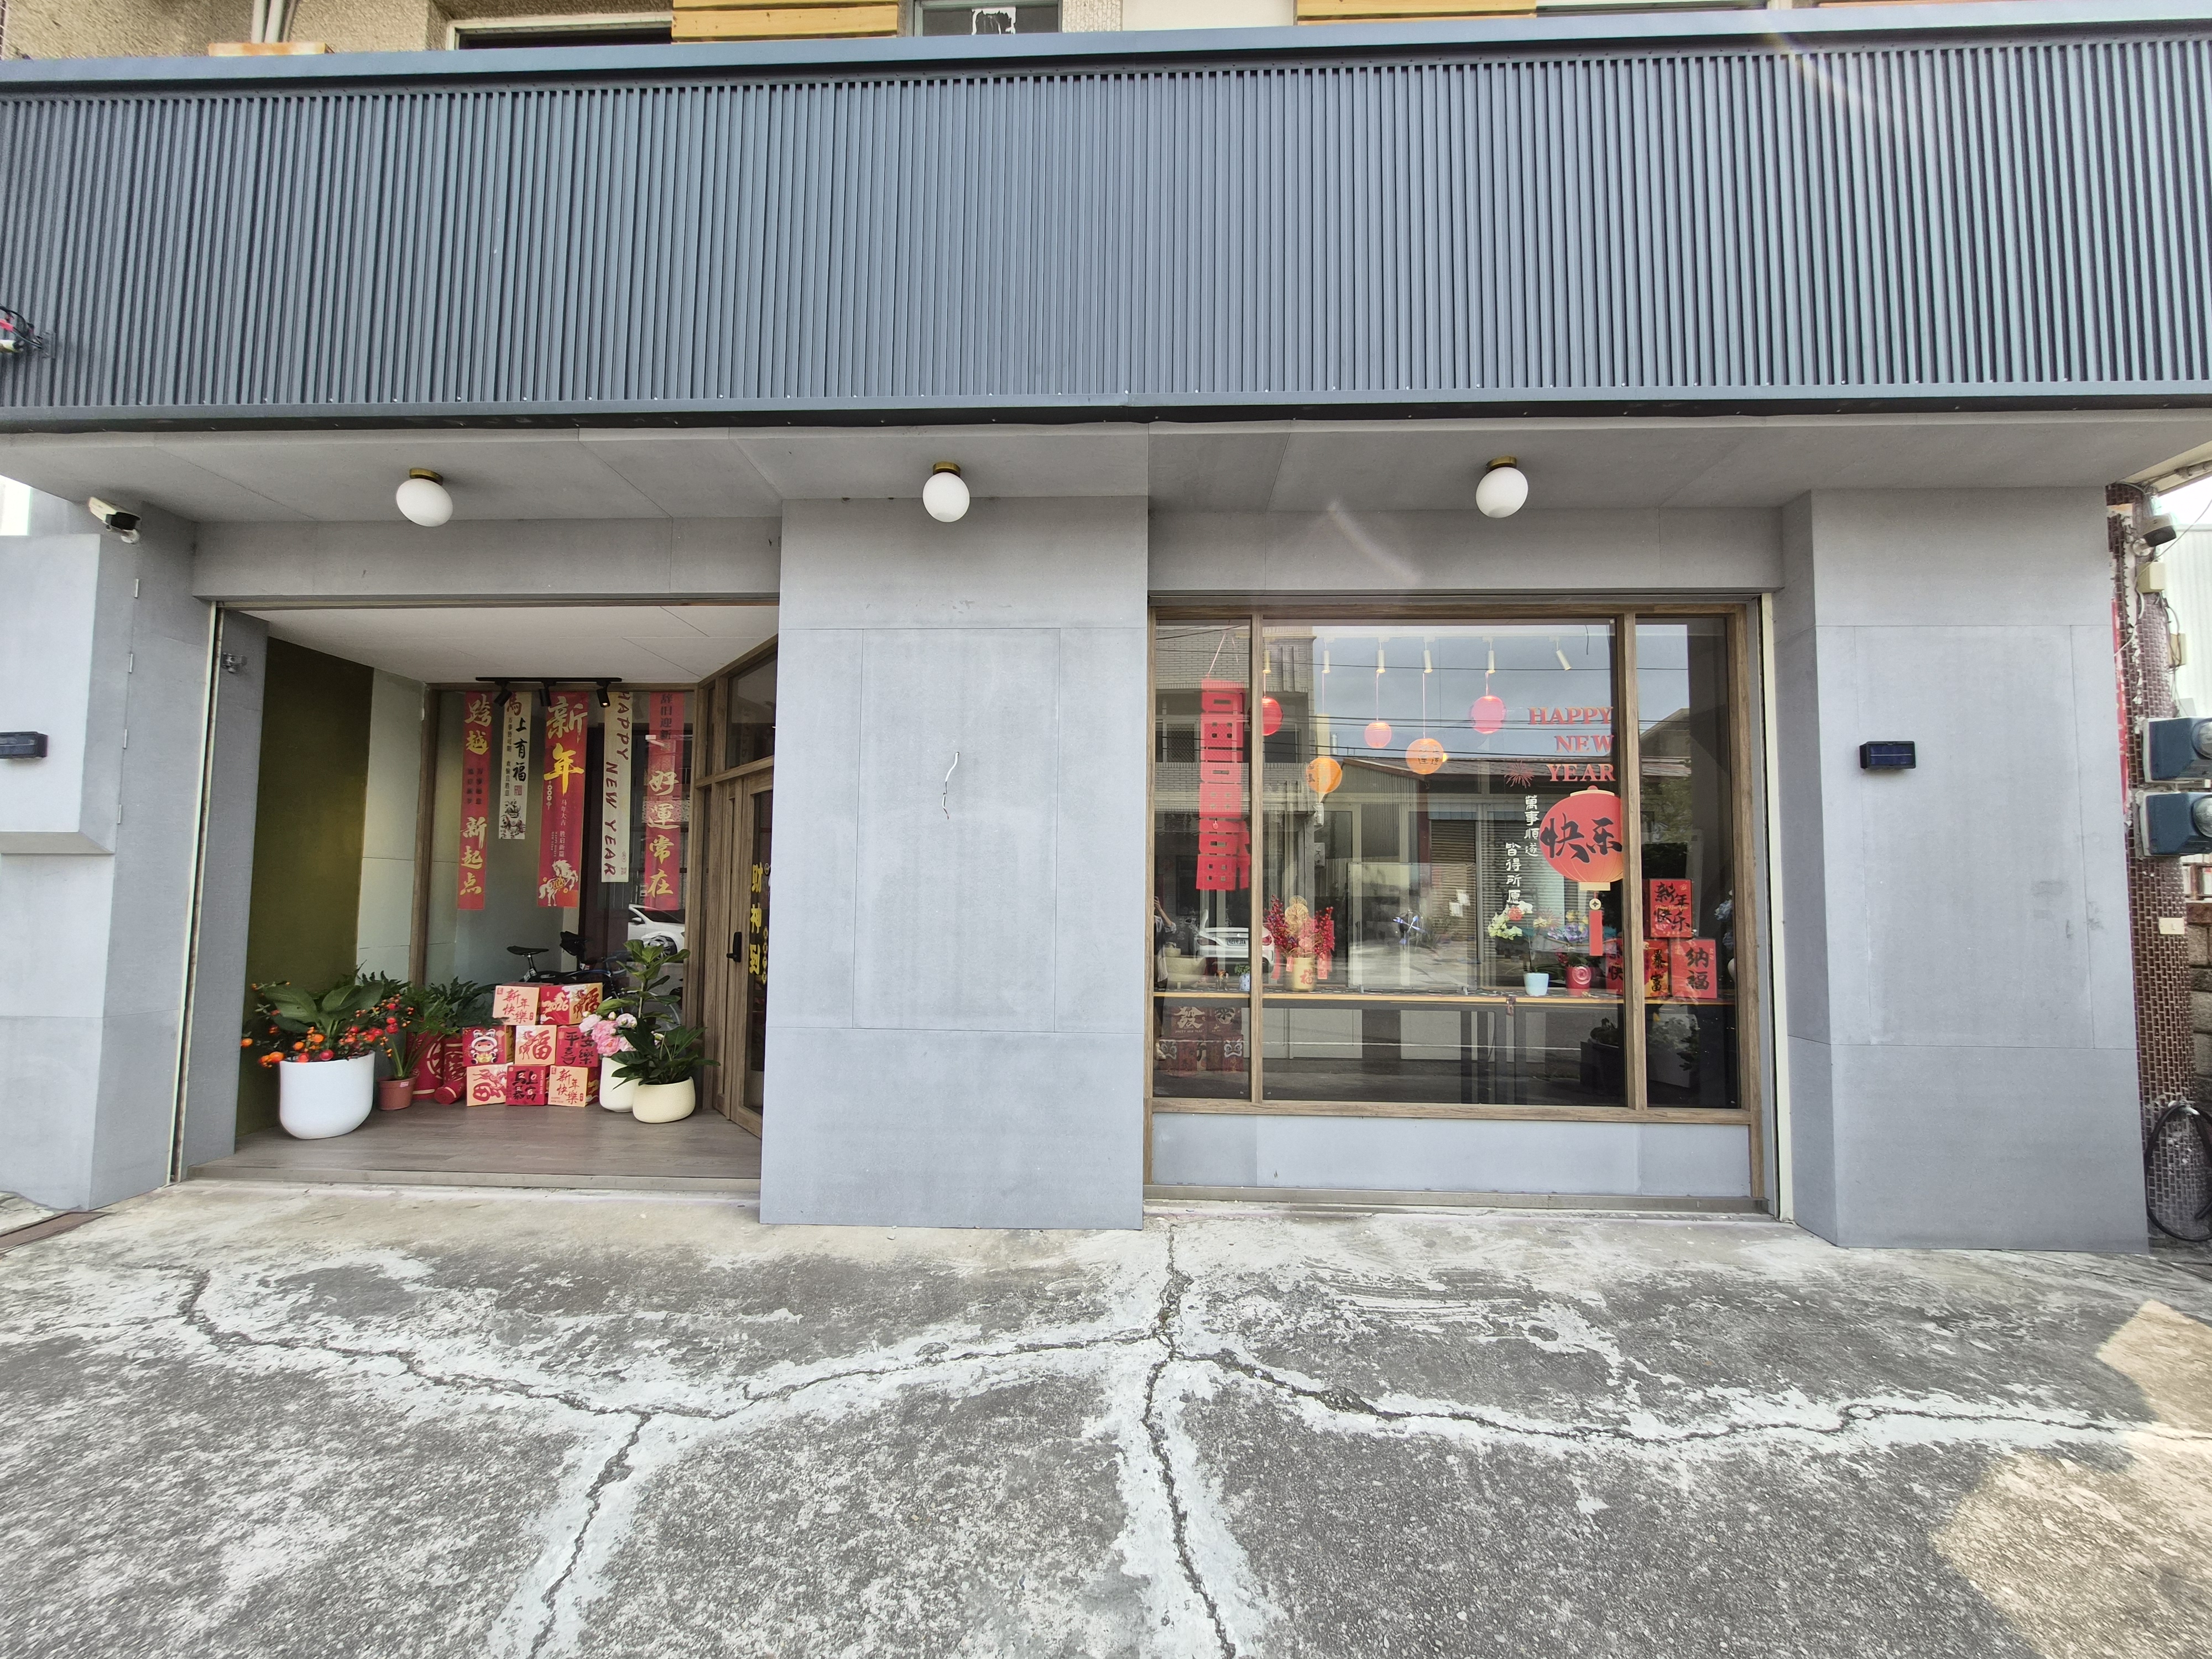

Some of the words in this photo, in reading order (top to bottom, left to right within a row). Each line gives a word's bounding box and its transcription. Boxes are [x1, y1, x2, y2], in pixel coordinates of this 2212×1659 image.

[465, 693, 492, 755] 跨越
[617, 691, 630, 760] HAPPY
[1528, 707, 1613, 725] HAPPY
[544, 696, 588, 796] 新年
[1554, 735, 1614, 753] NEW
[606, 761, 618, 809] NEW
[1546, 764, 1615, 781] YEAR
[604, 820, 616, 876] YEAR
[647, 770, 680, 898] 好運常在
[1524, 795, 1540, 857] 萬事順遂
[1540, 813, 1623, 863] 快乐
[460, 816, 487, 896] 新起点
[1505, 842, 1522, 905] 皆得所愿
[1686, 947, 1709, 990] 纳福
[542, 1000, 569, 1012] 2026
[565, 1031, 594, 1047] 平安
